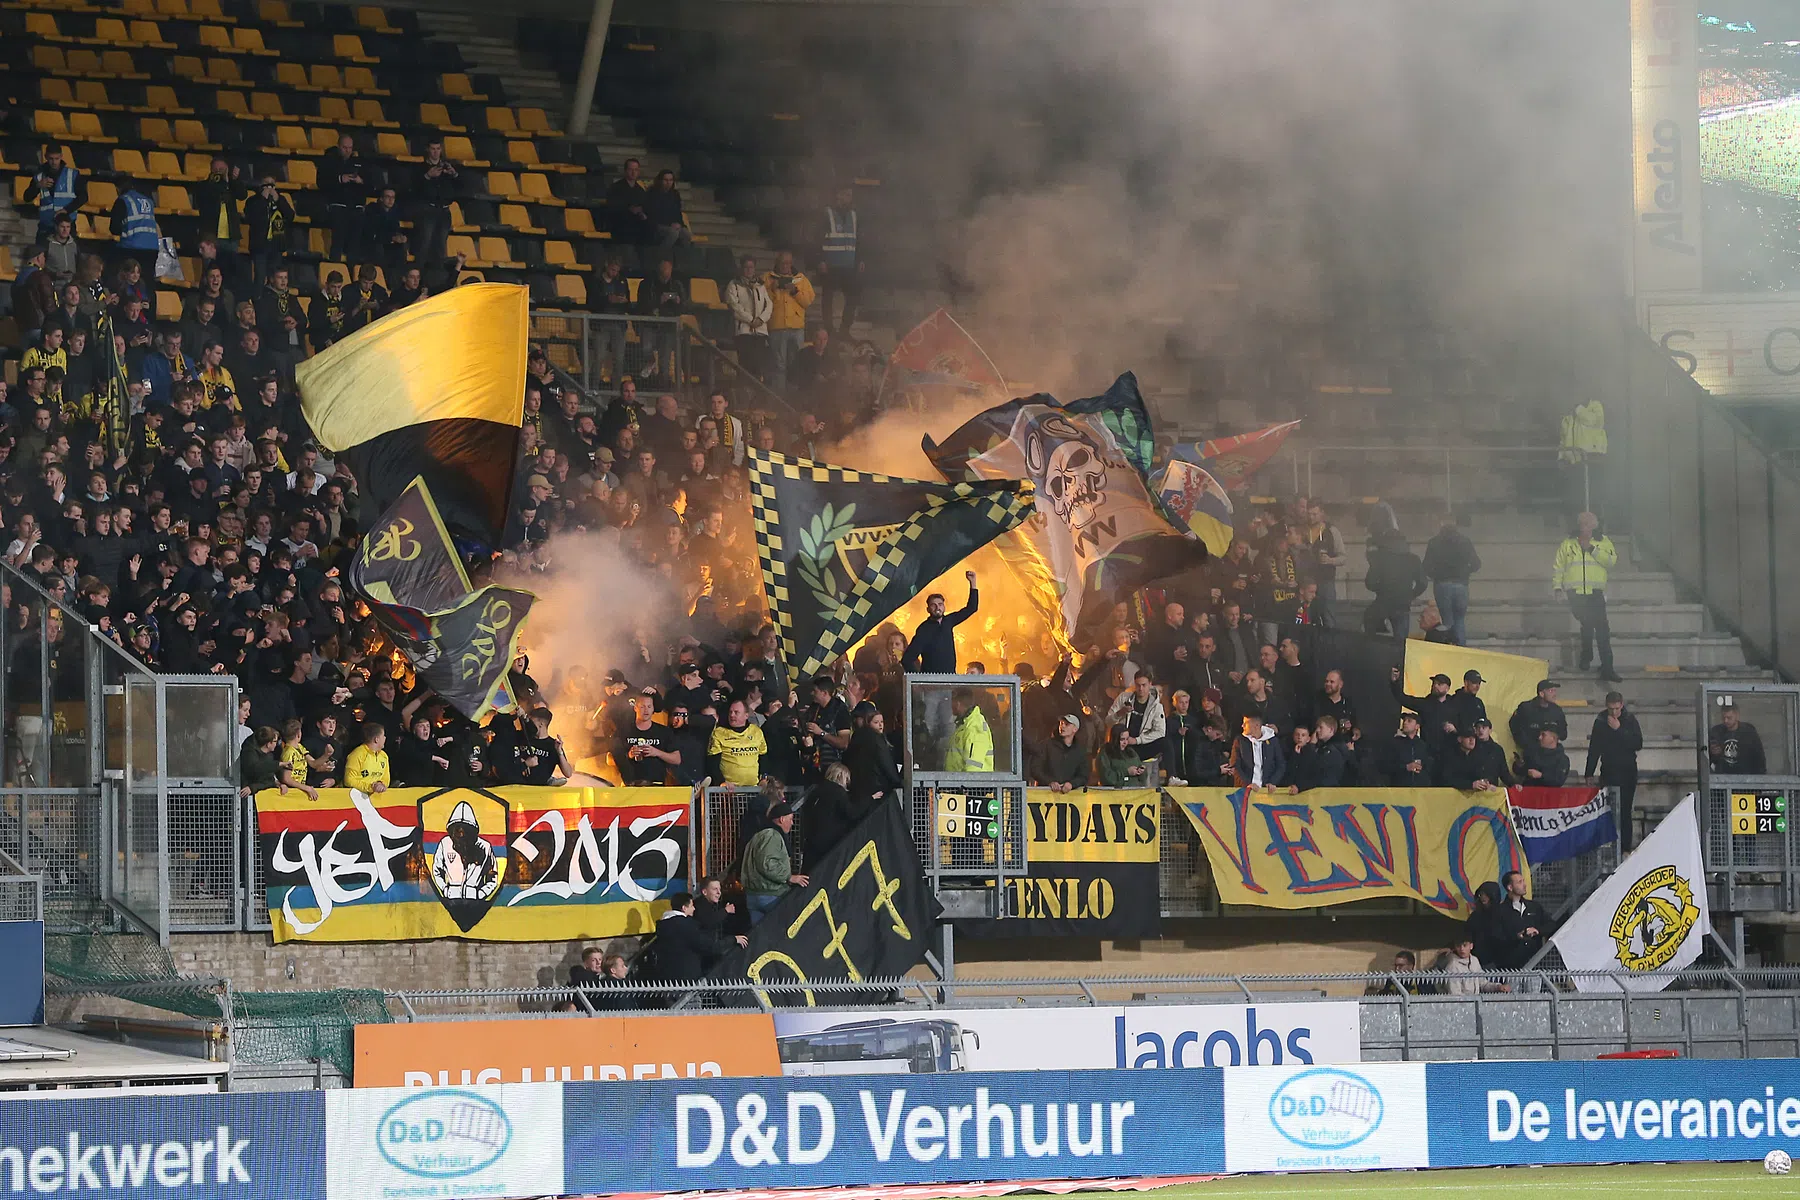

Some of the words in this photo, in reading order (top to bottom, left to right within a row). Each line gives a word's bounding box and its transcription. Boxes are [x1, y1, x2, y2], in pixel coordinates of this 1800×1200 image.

[1642, 118, 1696, 256] Alecto
[967, 799, 983, 814] 17
[1757, 797, 1771, 811] 19
[967, 820, 982, 836] 19
[1759, 818, 1772, 832] 21
[507, 808, 684, 907] 2013
[1183, 788, 1523, 911] VENLO
[1612, 868, 1675, 934] VRIENDENGROEP
[1280, 1095, 1327, 1117] D&D
[1487, 1089, 1550, 1142] De
[388, 1118, 445, 1144] D&D
[675, 1090, 836, 1169] D&D
[859, 1086, 1135, 1163] Verhuur
[1301, 1127, 1351, 1141] Verhuur
[413, 1152, 474, 1168] Verhuur
